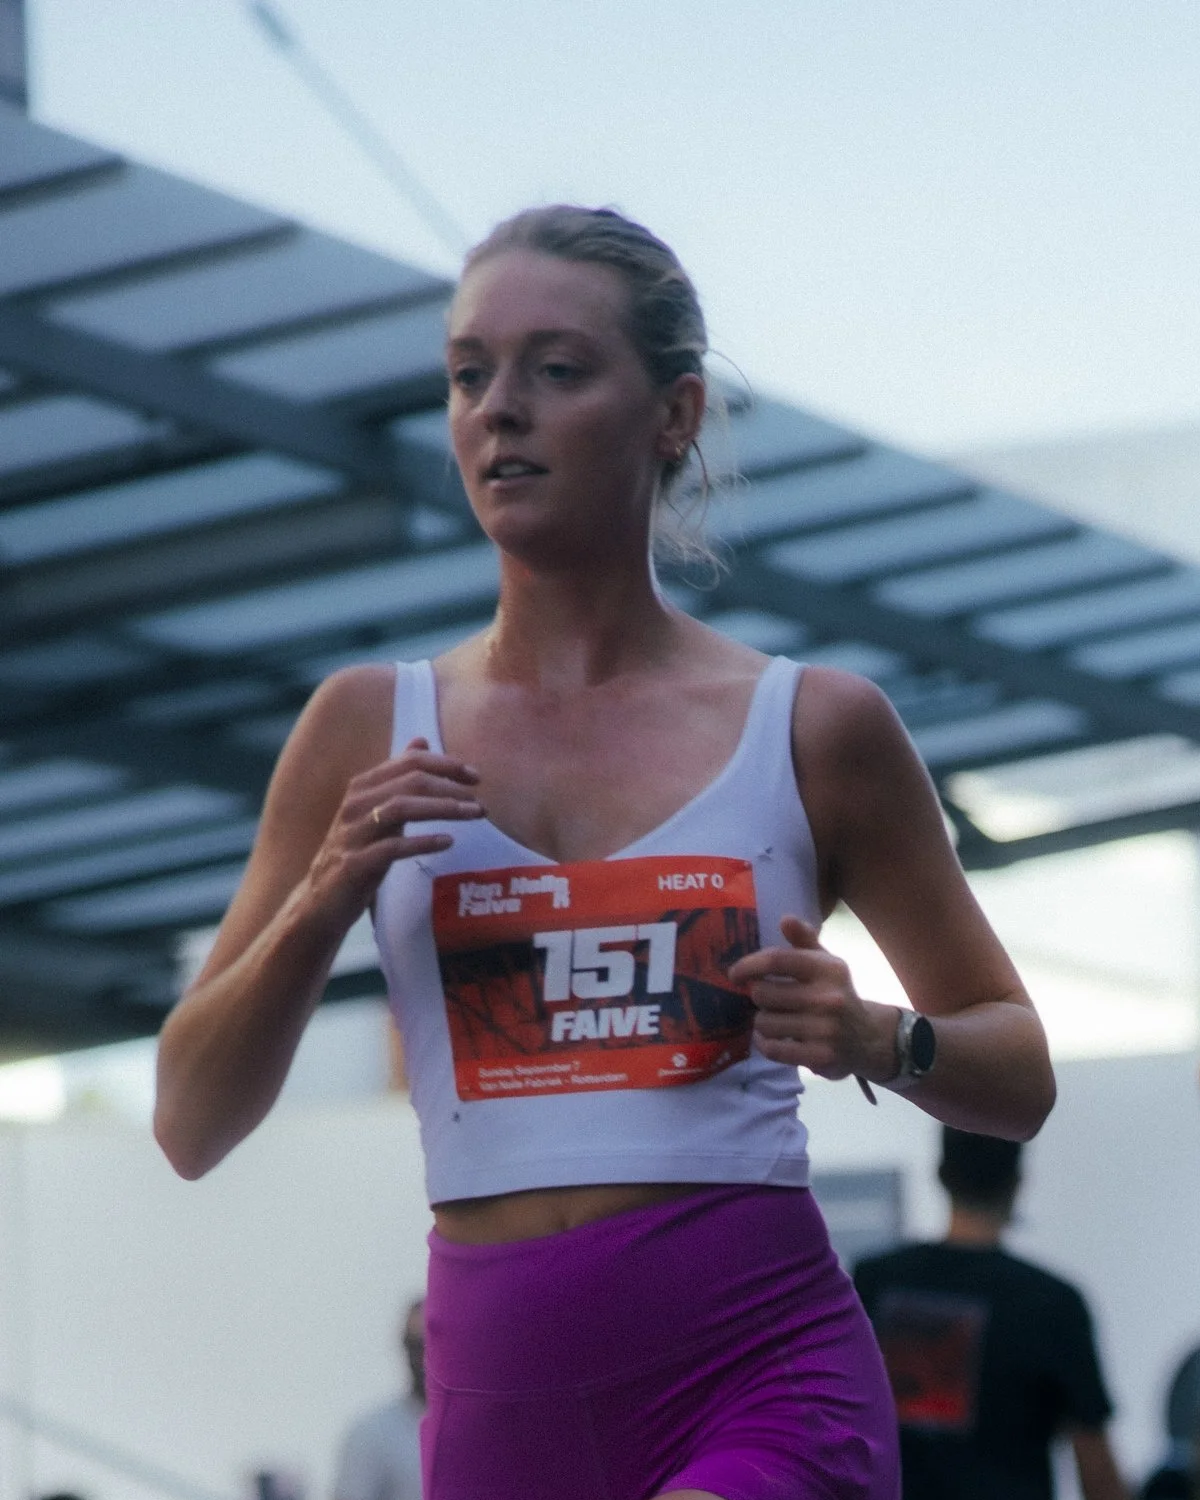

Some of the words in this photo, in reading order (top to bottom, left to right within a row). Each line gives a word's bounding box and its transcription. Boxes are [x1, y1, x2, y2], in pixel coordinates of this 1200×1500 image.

[657, 872, 708, 891] HEAT
[711, 871, 724, 889] 0
[533, 922, 678, 1002] 151
[551, 1004, 662, 1042] FAIVE
